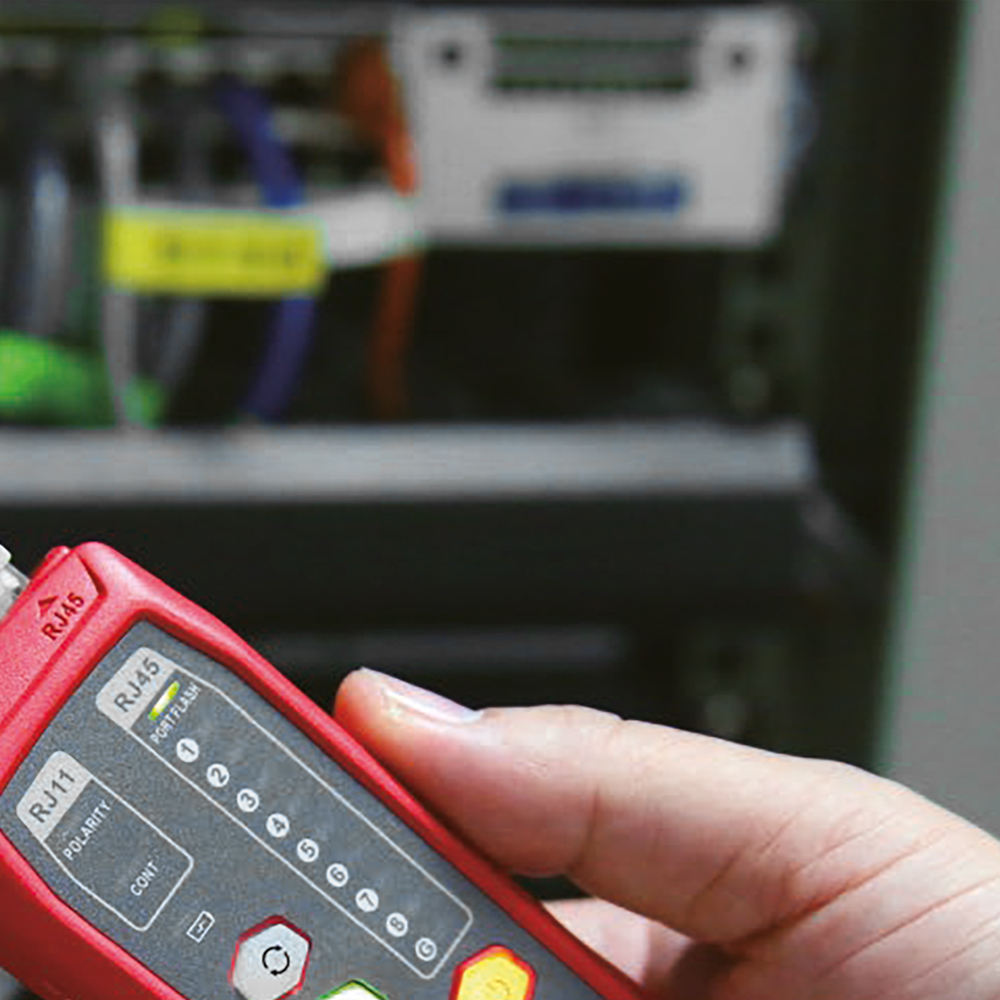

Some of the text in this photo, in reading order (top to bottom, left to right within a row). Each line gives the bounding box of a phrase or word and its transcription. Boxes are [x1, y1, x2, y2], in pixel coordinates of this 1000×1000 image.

[41, 592, 85, 640] RJ45
[114, 657, 159, 713] RJ45
[179, 740, 198, 760] 1
[209, 765, 228, 786] 2
[29, 769, 75, 823] RJ11
[239, 790, 258, 811] 3
[63, 800, 111, 861] POLARITY
[268, 815, 288, 836] 4
[298, 840, 318, 861] 5
[130, 860, 159, 896] CONT
[327, 865, 347, 886] 6
[357, 890, 377, 911] 7
[387, 914, 407, 935] 8
